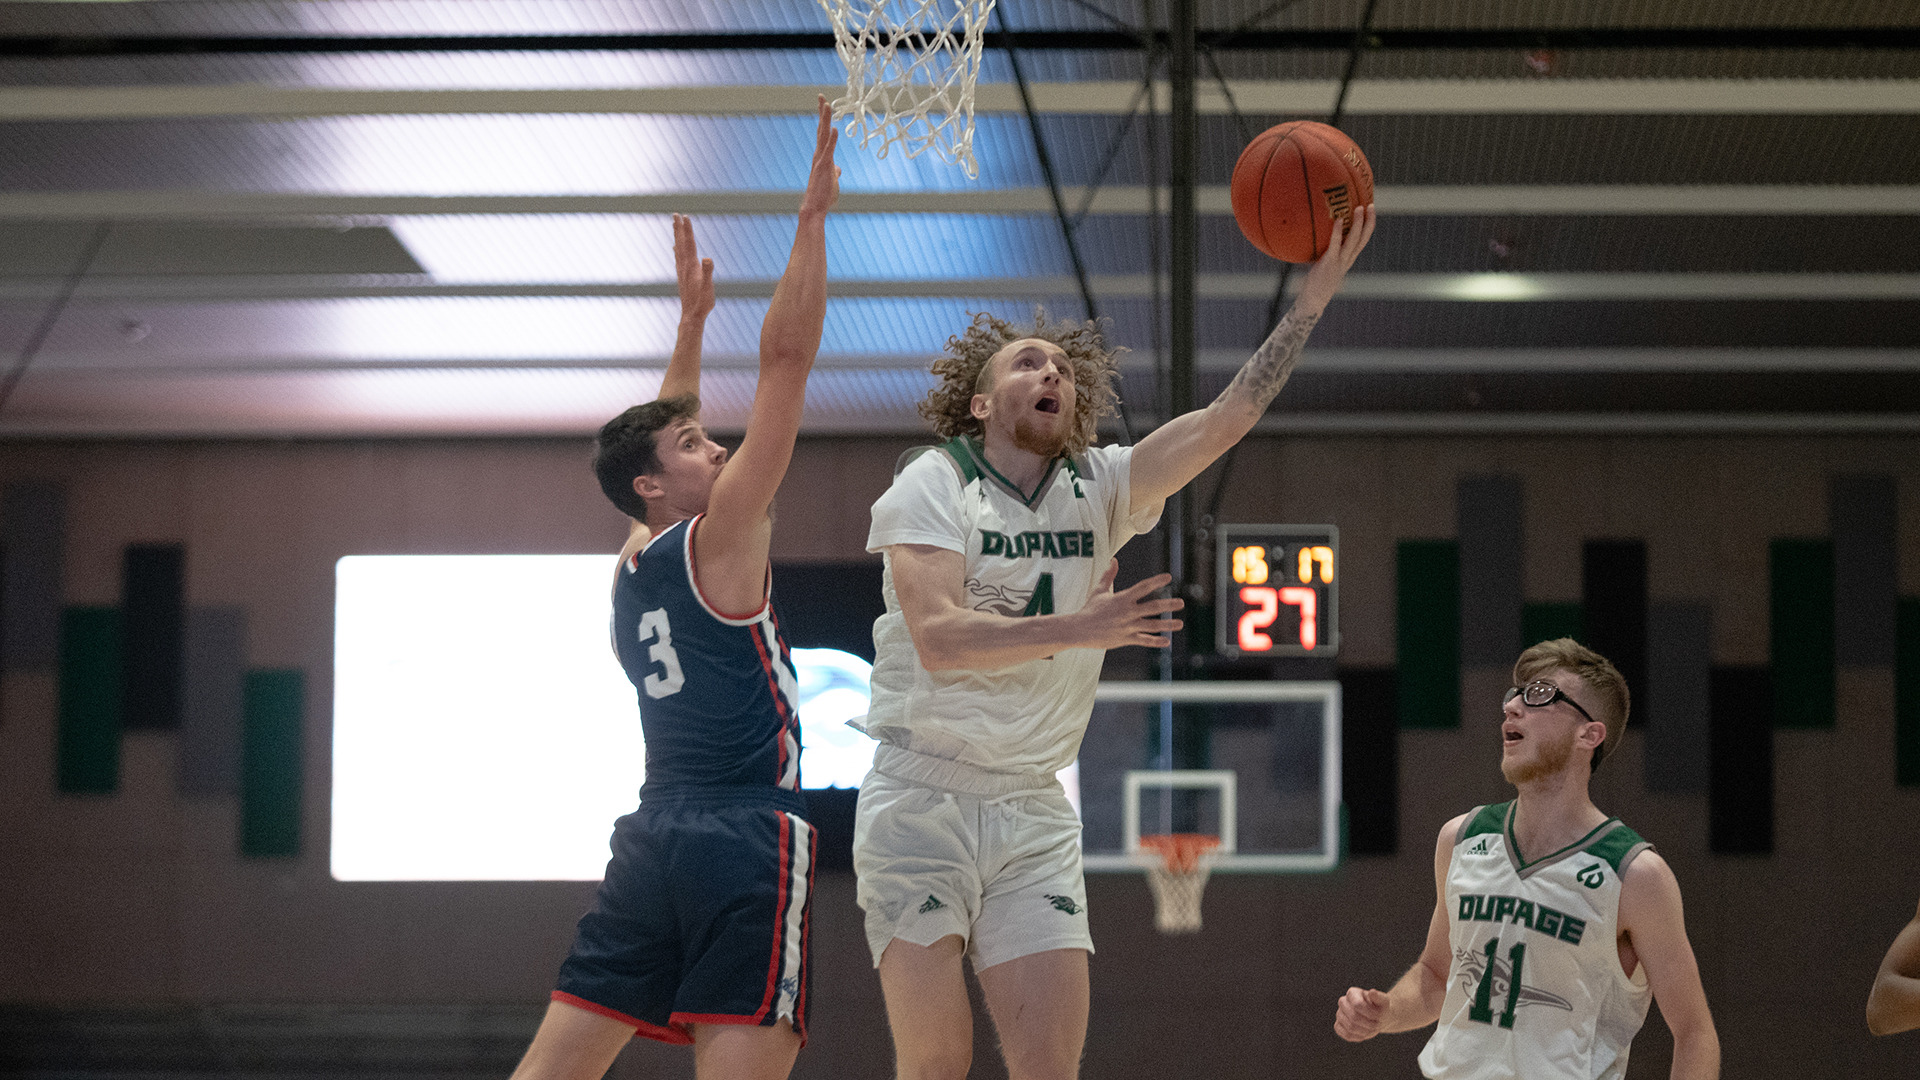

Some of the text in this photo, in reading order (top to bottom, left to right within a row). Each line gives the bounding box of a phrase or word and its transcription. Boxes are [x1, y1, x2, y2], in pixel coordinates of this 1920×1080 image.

[978, 528, 1094, 559] DUPAGE
[1232, 546, 1334, 584] 15 17
[1238, 587, 1316, 651] 27
[639, 607, 685, 699] 3
[1458, 894, 1587, 946] DUPAGE
[1468, 937, 1526, 1030] 11
